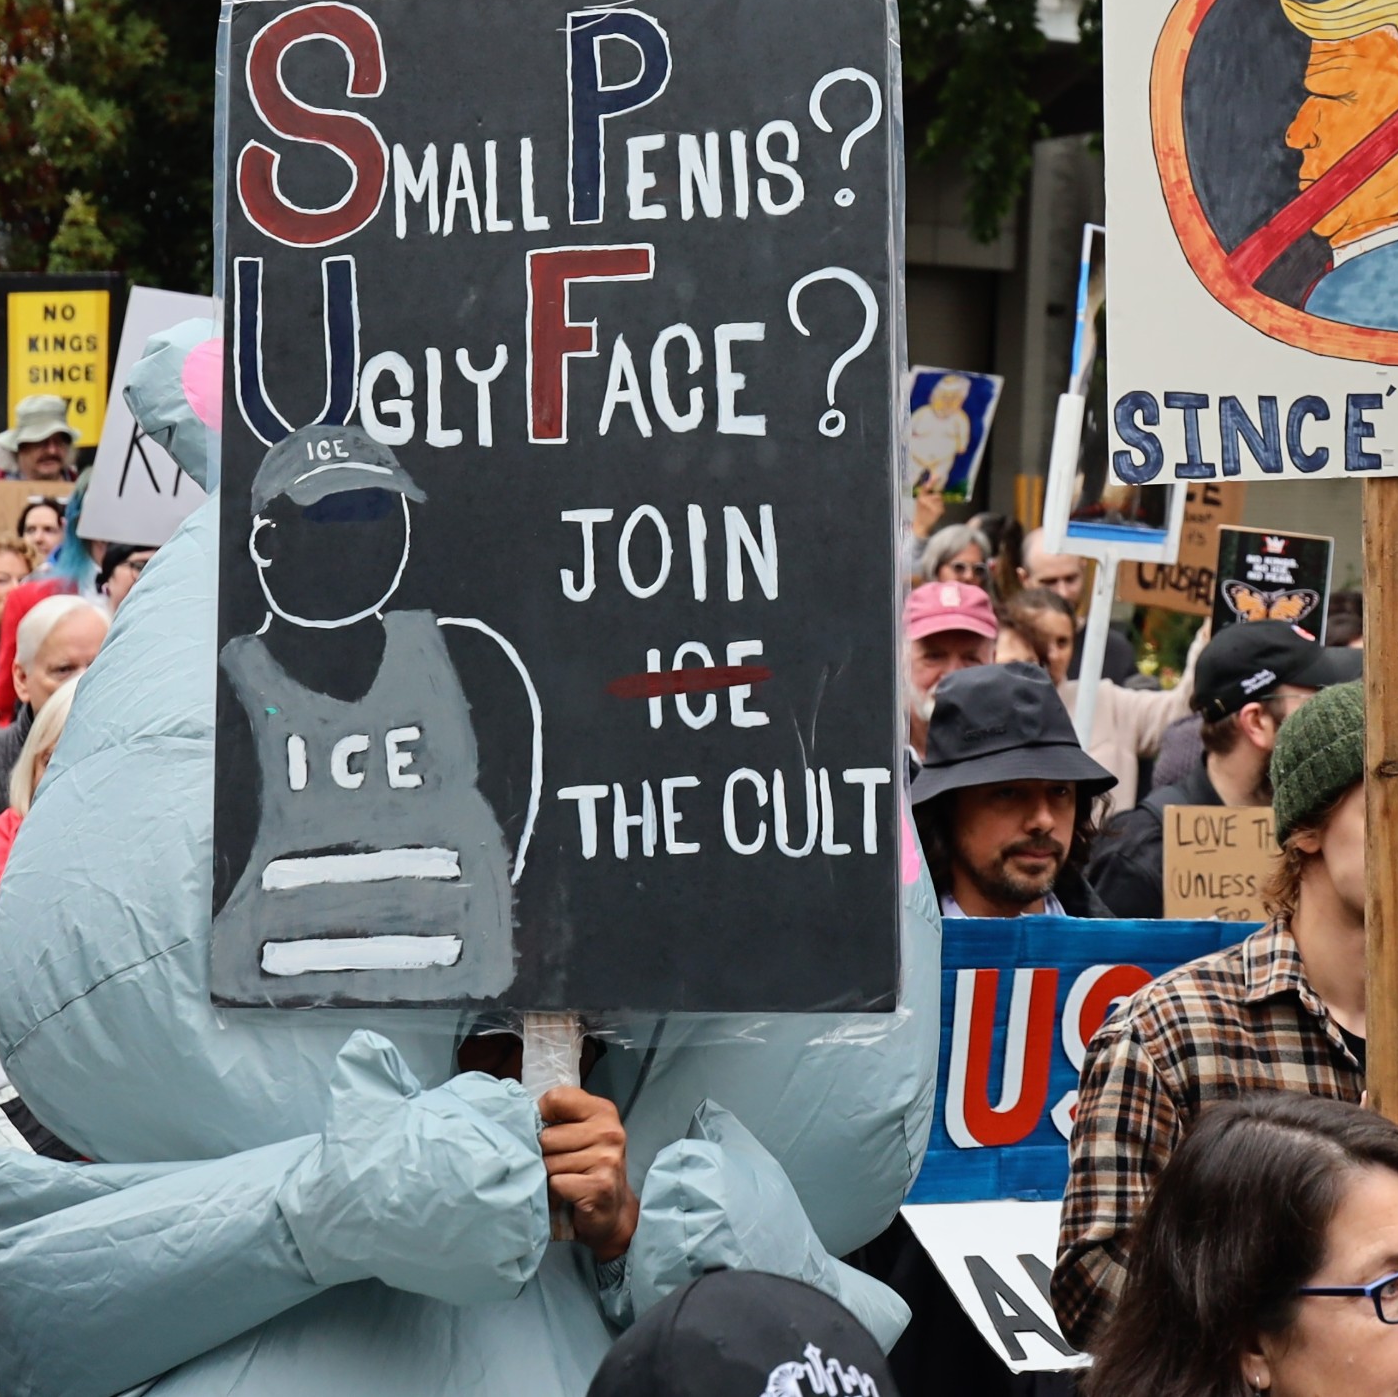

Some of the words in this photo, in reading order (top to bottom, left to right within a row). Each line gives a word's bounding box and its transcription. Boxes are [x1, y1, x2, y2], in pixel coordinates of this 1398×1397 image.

[44, 305, 75, 321] NO
[28, 335, 98, 352] KINGS
[29, 365, 95, 384] SINCE
[307, 439, 350, 462] ICE
[560, 504, 779, 602] JOIN
[646, 639, 770, 729] ICE
[286, 725, 423, 792] ICE
[557, 776, 702, 859] THE
[722, 766, 891, 858] CULT
[1176, 812, 1237, 847] LOVE
